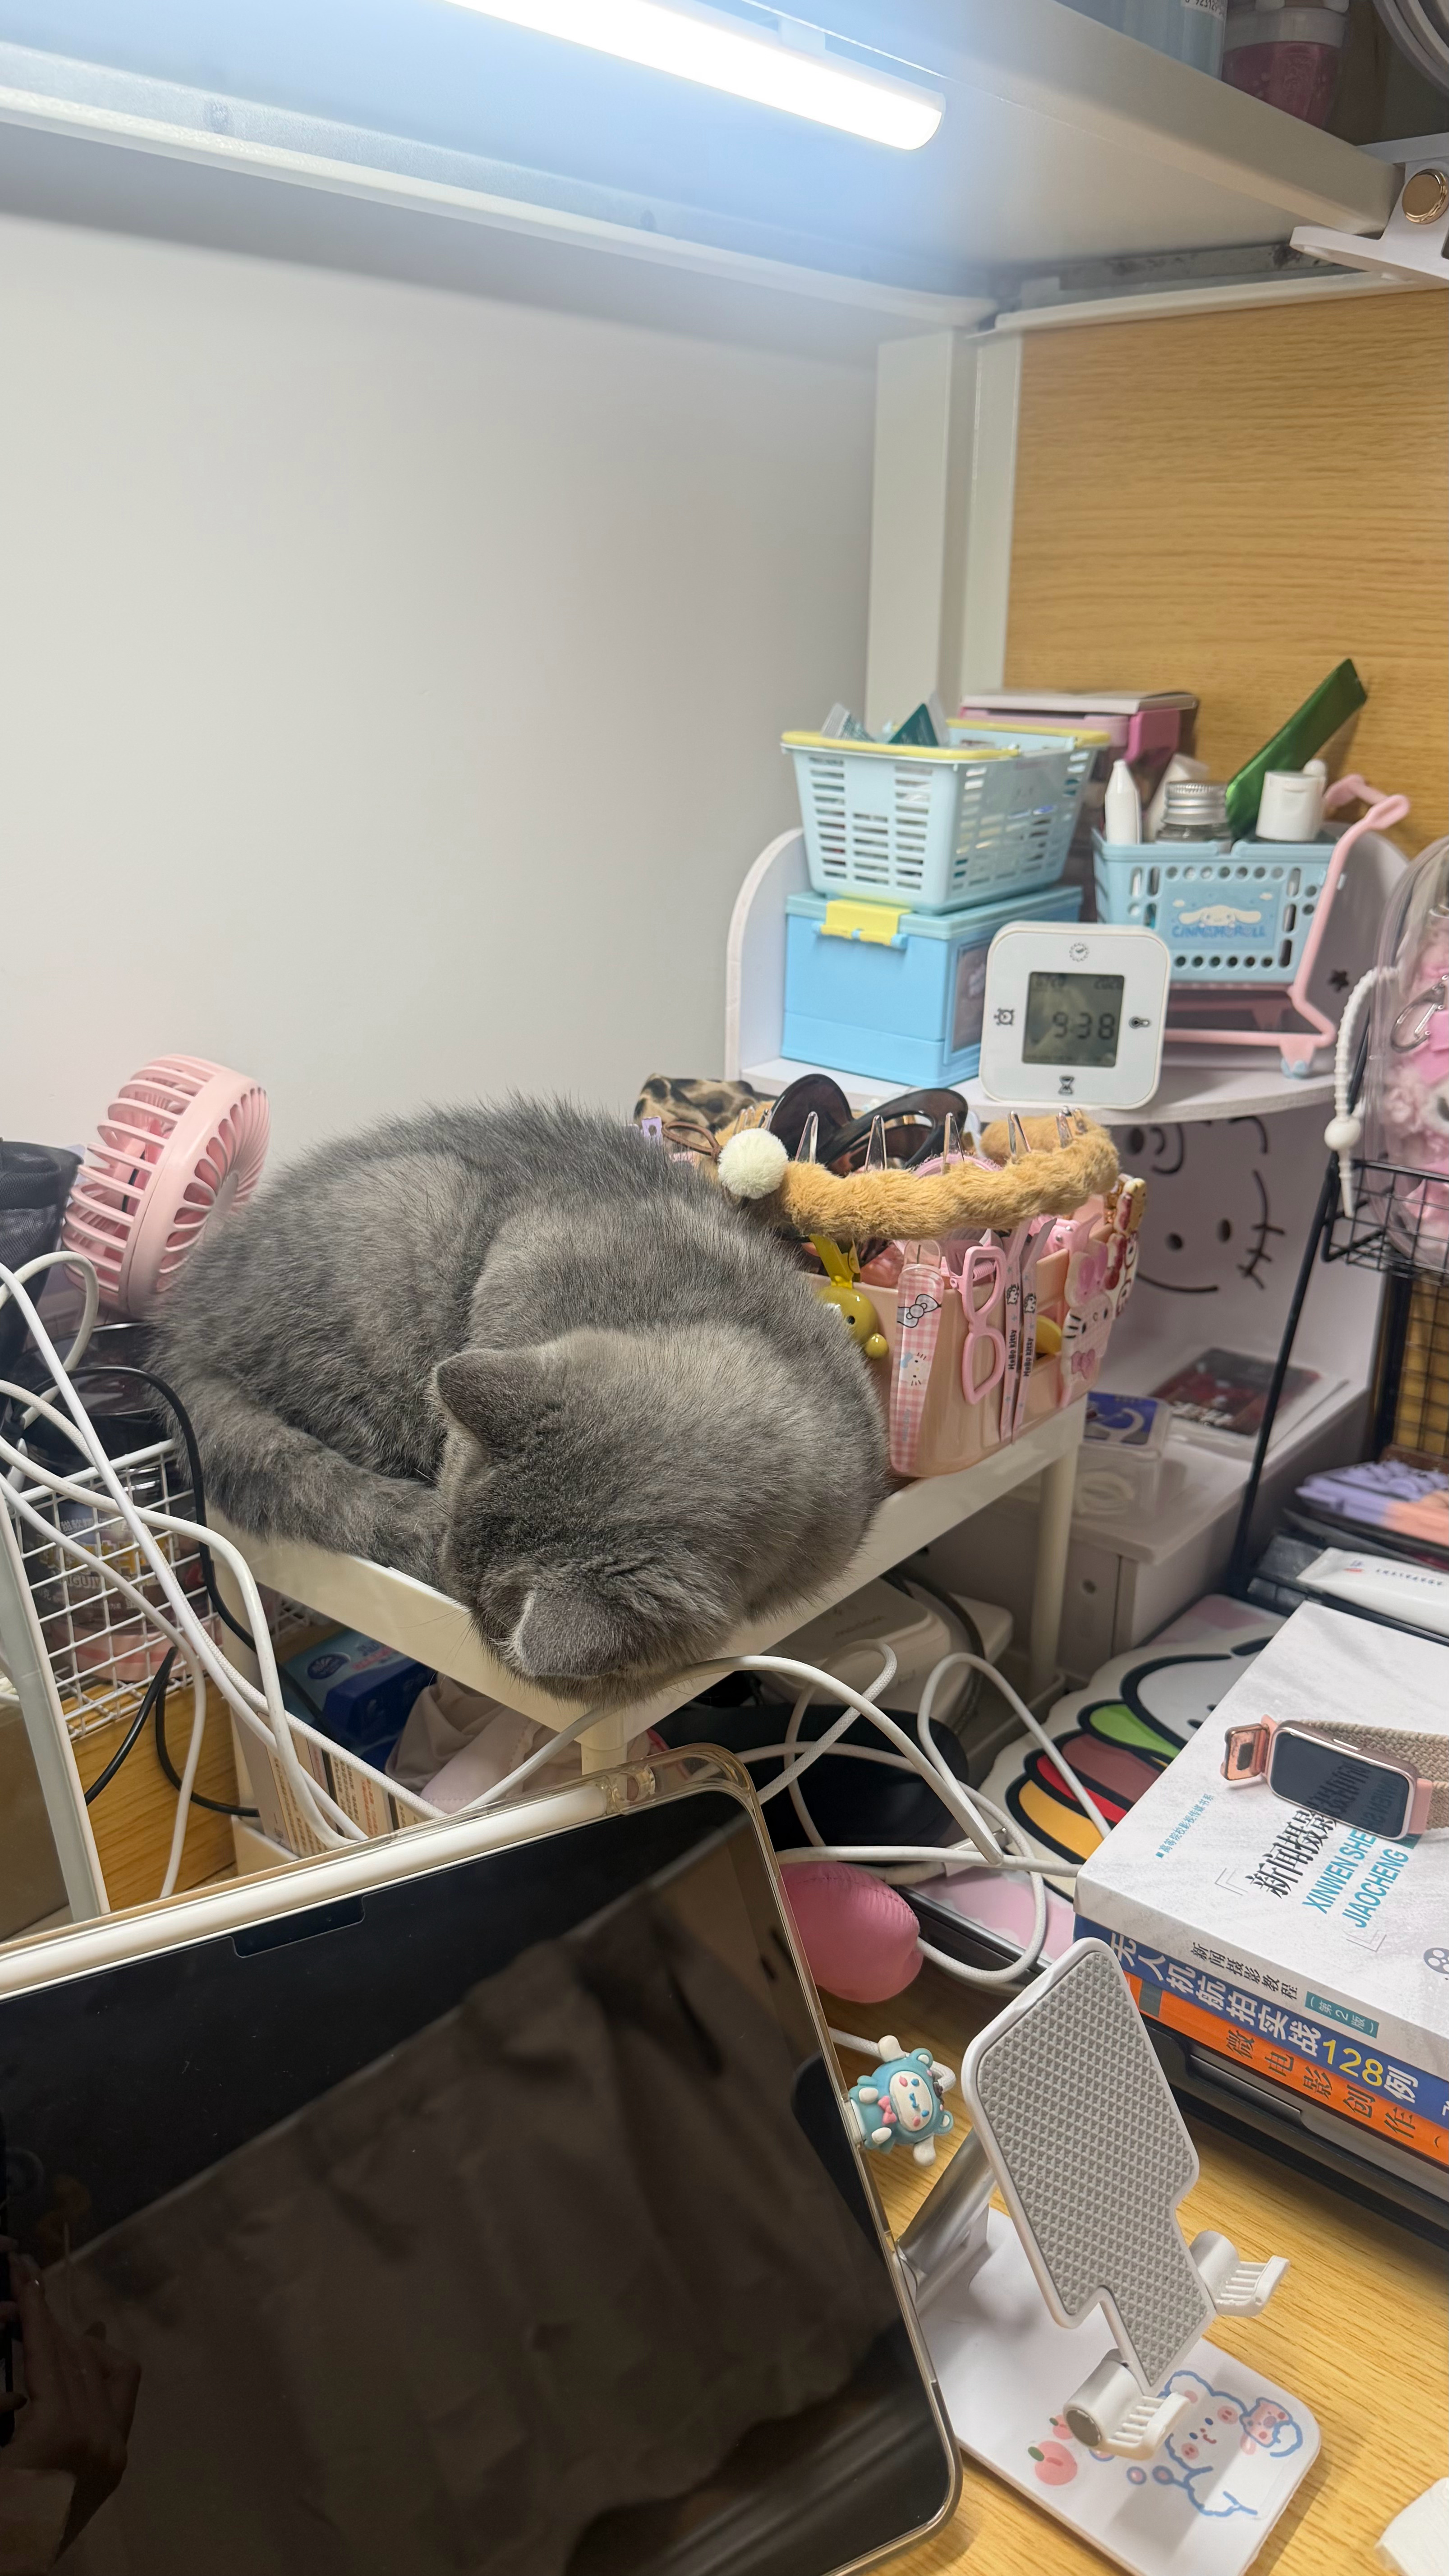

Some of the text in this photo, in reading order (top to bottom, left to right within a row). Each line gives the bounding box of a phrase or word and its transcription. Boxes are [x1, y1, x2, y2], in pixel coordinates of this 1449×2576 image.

[1302, 1855, 1359, 1914] XINWEN
[1342, 1849, 1409, 1928] JIAOCHENG
[1190, 1942, 1298, 2000] 新闻摄影教程
[1110, 1932, 1418, 2104] 无人机航拍实战128例
